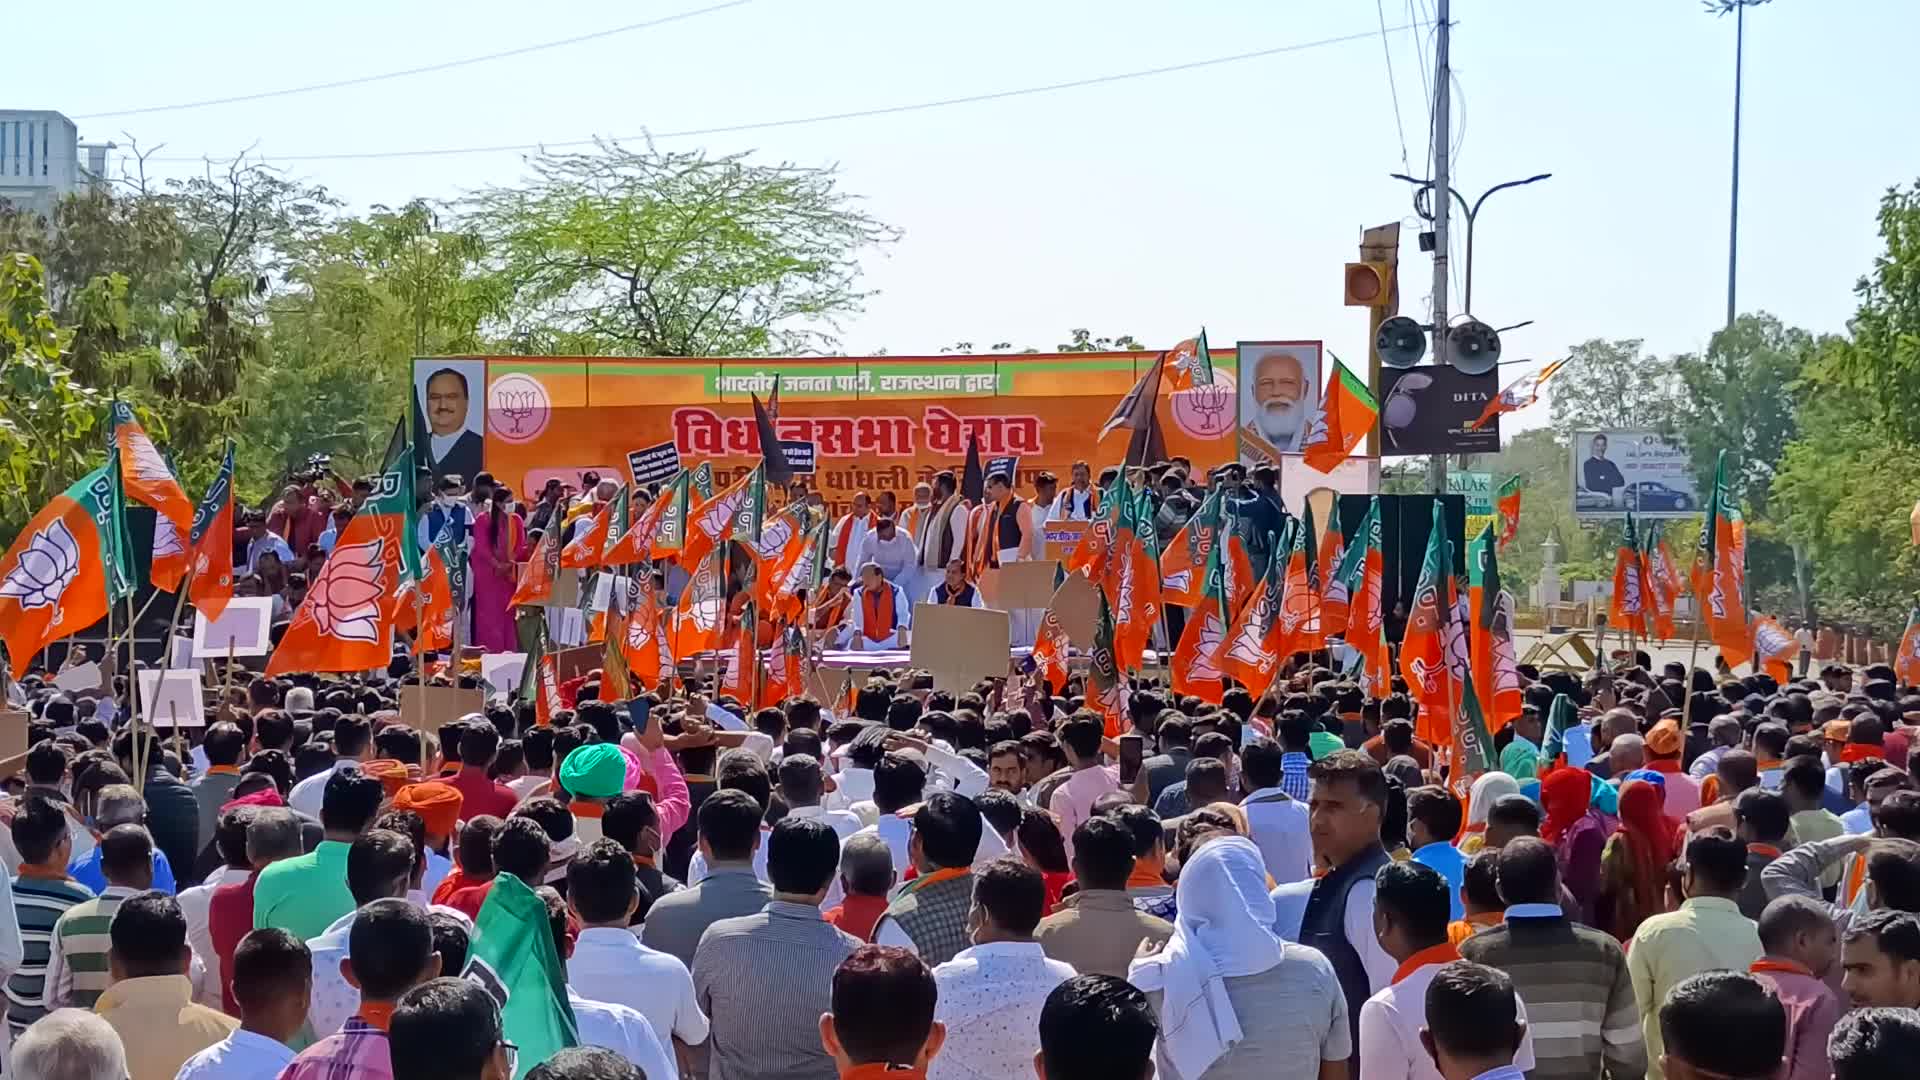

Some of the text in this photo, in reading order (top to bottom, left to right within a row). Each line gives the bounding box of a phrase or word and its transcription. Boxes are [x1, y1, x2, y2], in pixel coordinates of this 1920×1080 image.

[782, 375, 832, 392] जनता
[880, 374, 960, 391] राजस्थान
[965, 373, 1001, 393] द्वारा
[1453, 391, 1489, 402] DITA
[673, 406, 1045, 456] विधनसभा घेराव
[825, 464, 909, 490] धांधली
